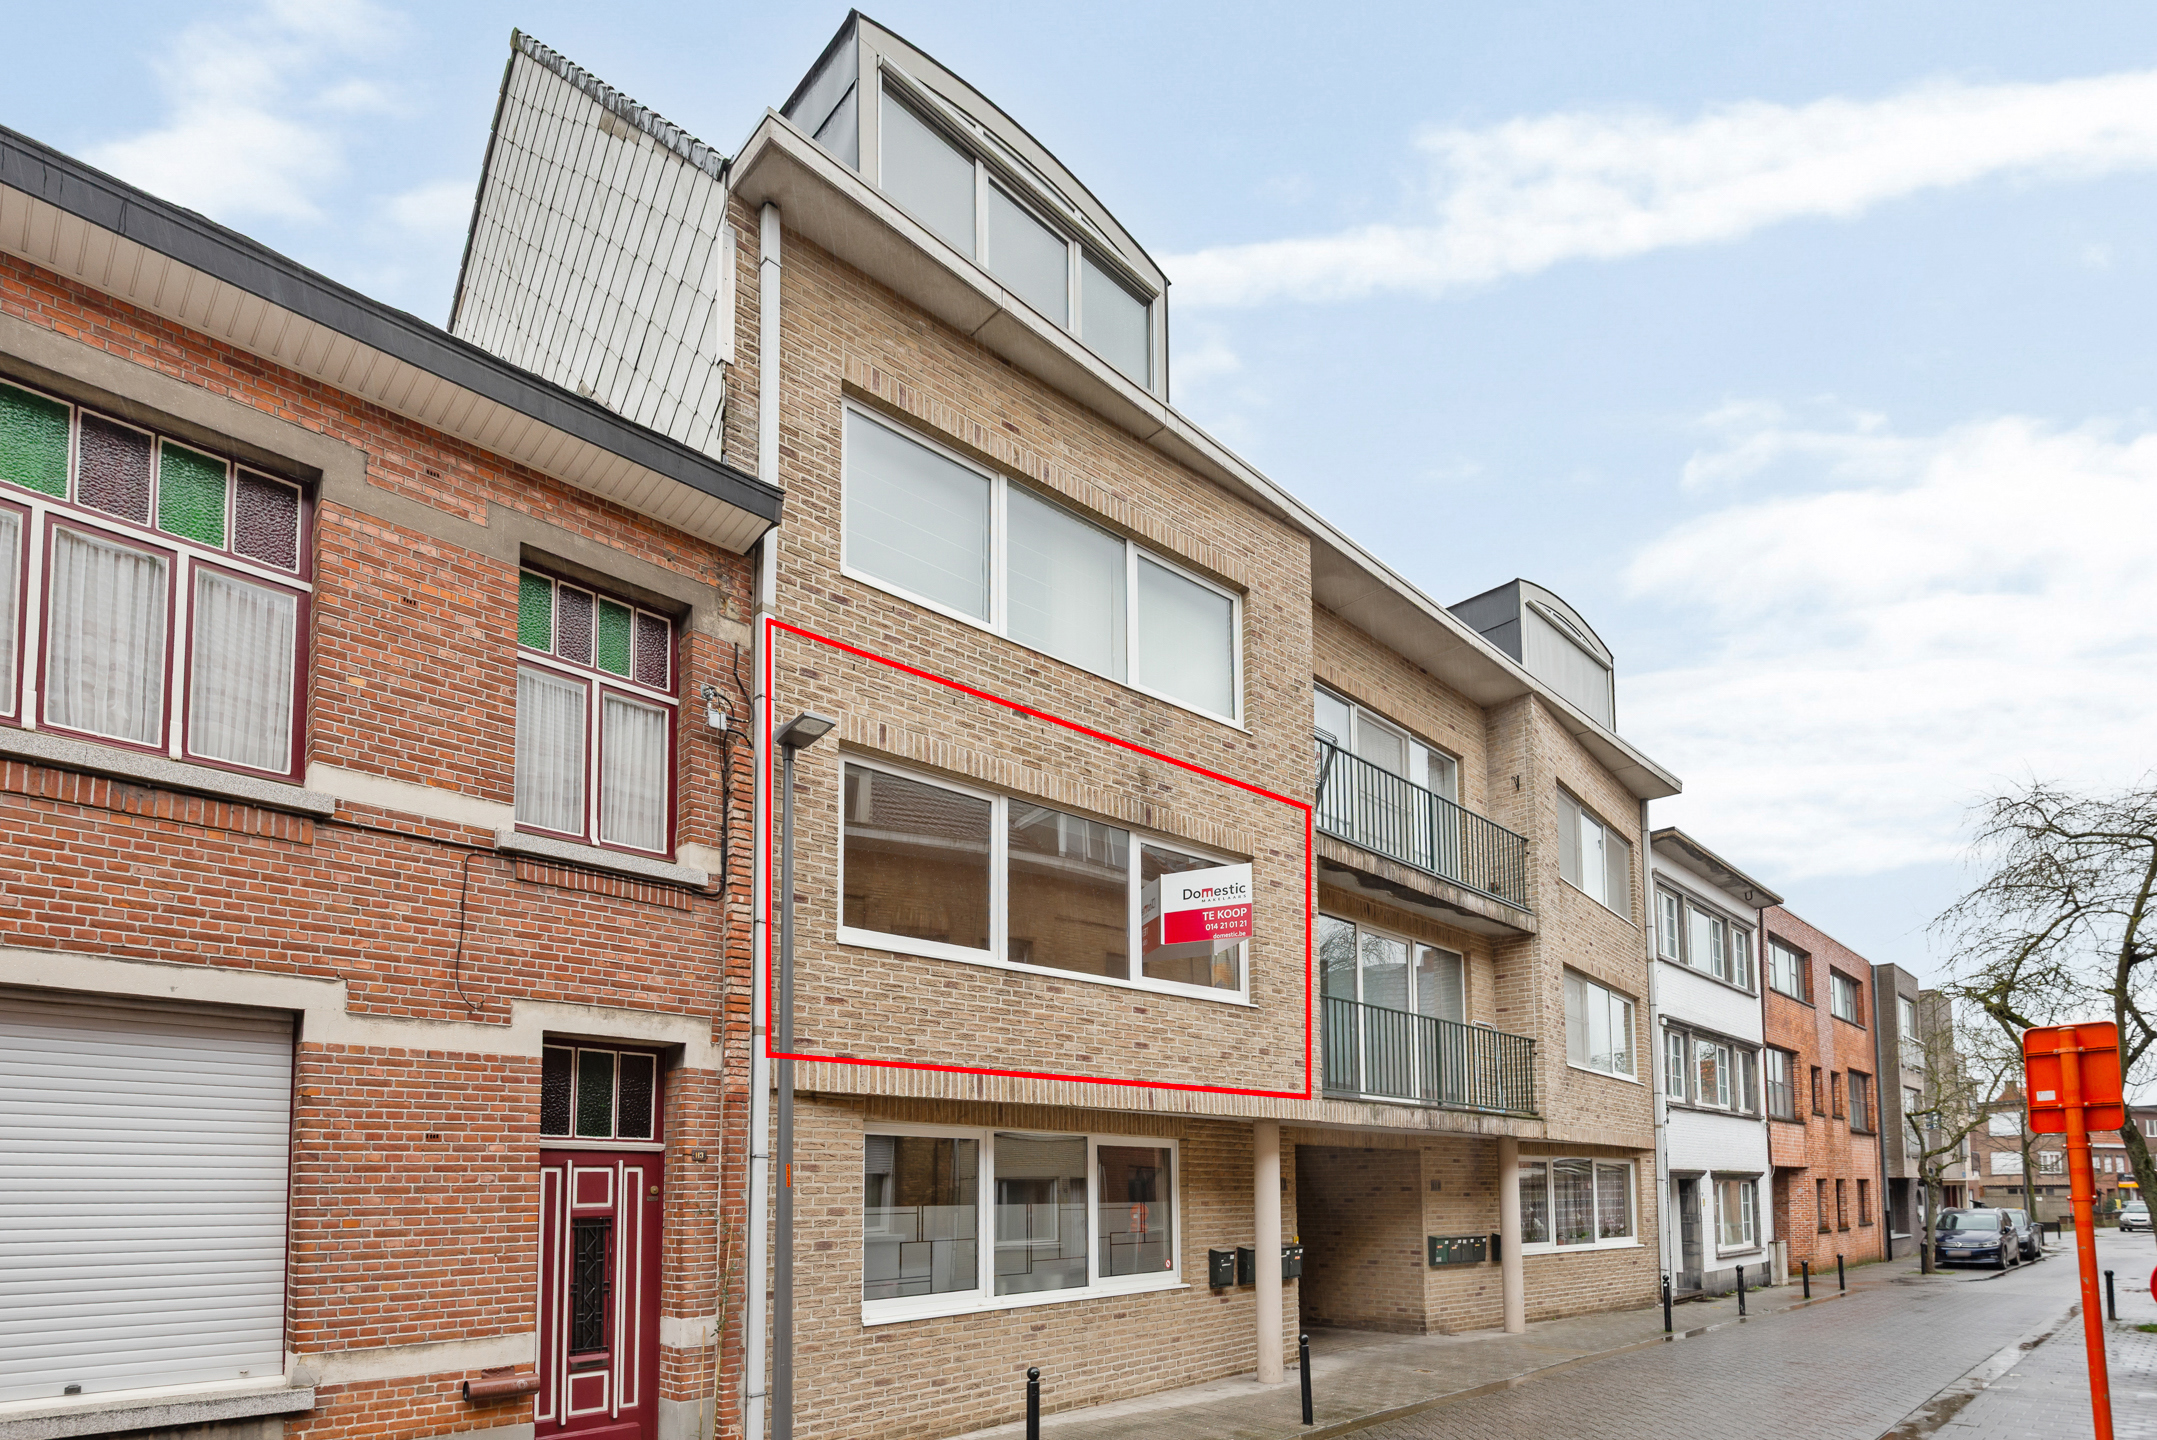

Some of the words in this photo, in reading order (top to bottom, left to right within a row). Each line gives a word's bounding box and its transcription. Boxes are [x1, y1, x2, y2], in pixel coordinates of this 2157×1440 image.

[1183, 883, 1246, 900] Domestic
[1201, 894, 1247, 903] MAKELAARS
[1202, 911, 1215, 921] TE
[1217, 907, 1248, 919] KOOP
[1205, 923, 1218, 931] 014
[1229, 920, 1238, 928] 01
[1239, 919, 1247, 927] 21
[1213, 931, 1246, 939] domestic.be
